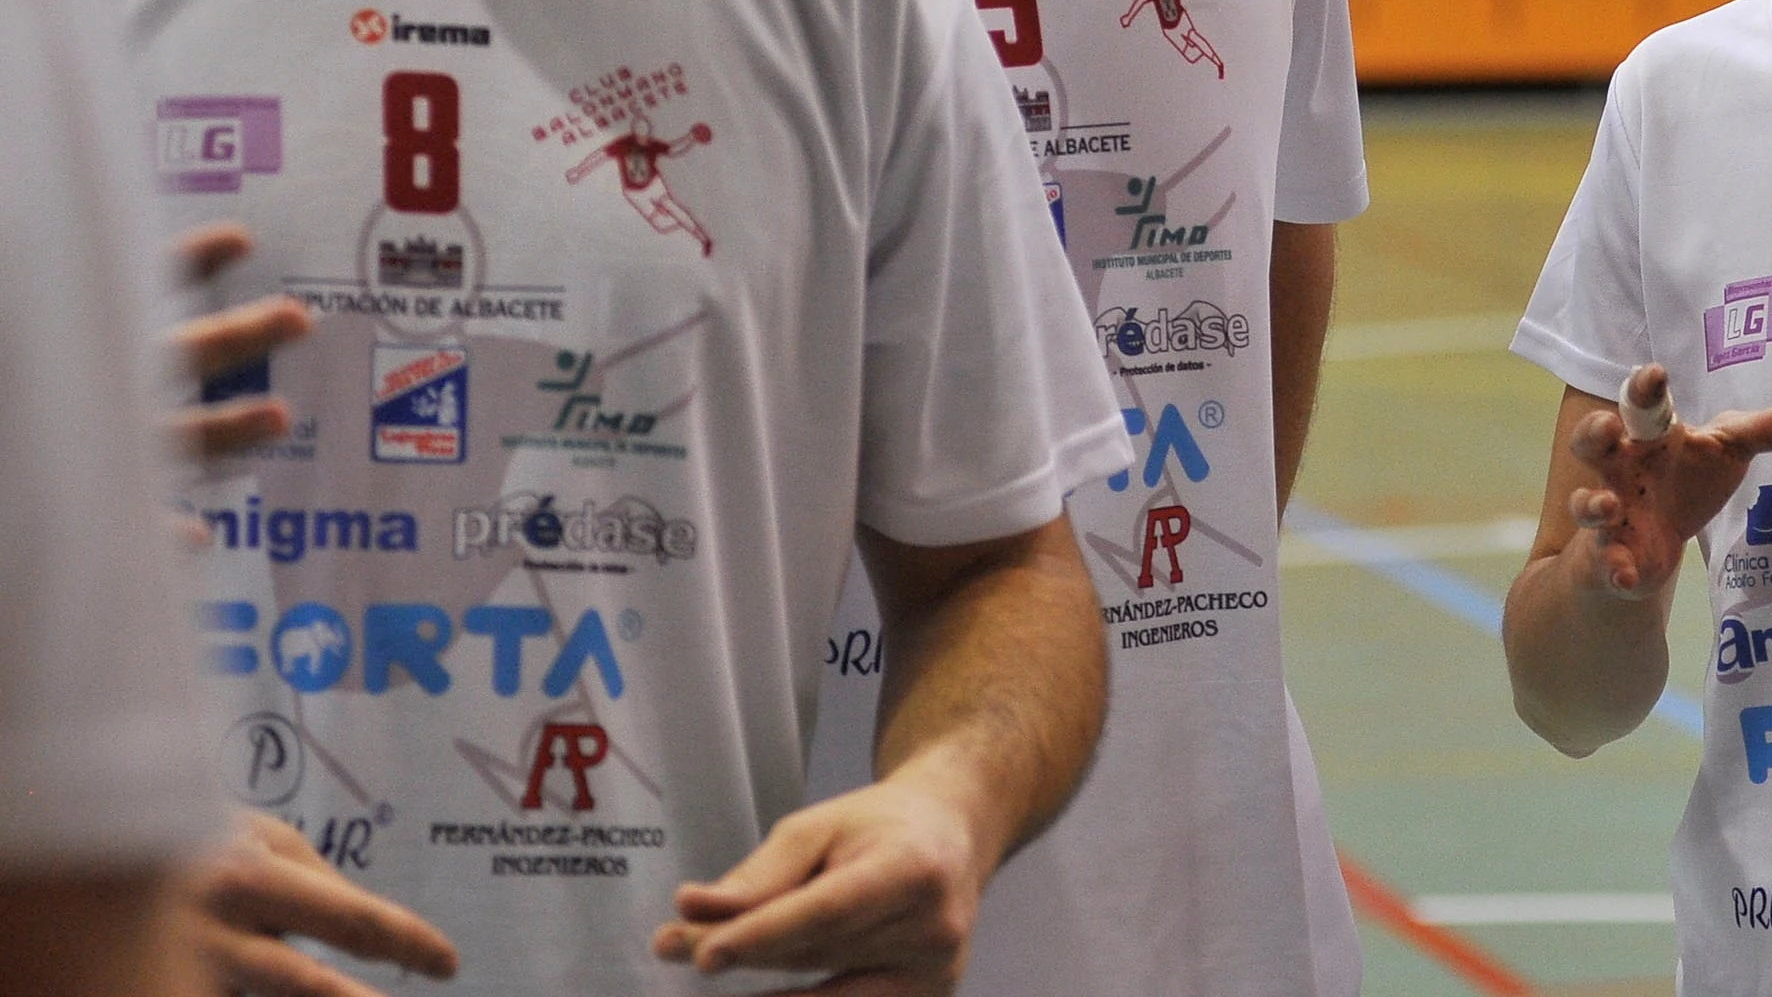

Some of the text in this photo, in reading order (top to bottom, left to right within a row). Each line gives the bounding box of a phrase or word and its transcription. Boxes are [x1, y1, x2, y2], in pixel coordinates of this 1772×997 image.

[391, 13, 491, 46] irema
[382, 71, 461, 214] 8
[1043, 134, 1132, 158] ALBACETE
[1146, 266, 1185, 281] ALBACETE
[1096, 307, 1250, 359] rédase
[1727, 303, 1765, 341] LG
[201, 497, 419, 562] nigma
[1122, 620, 1219, 649] INGENIEROS
